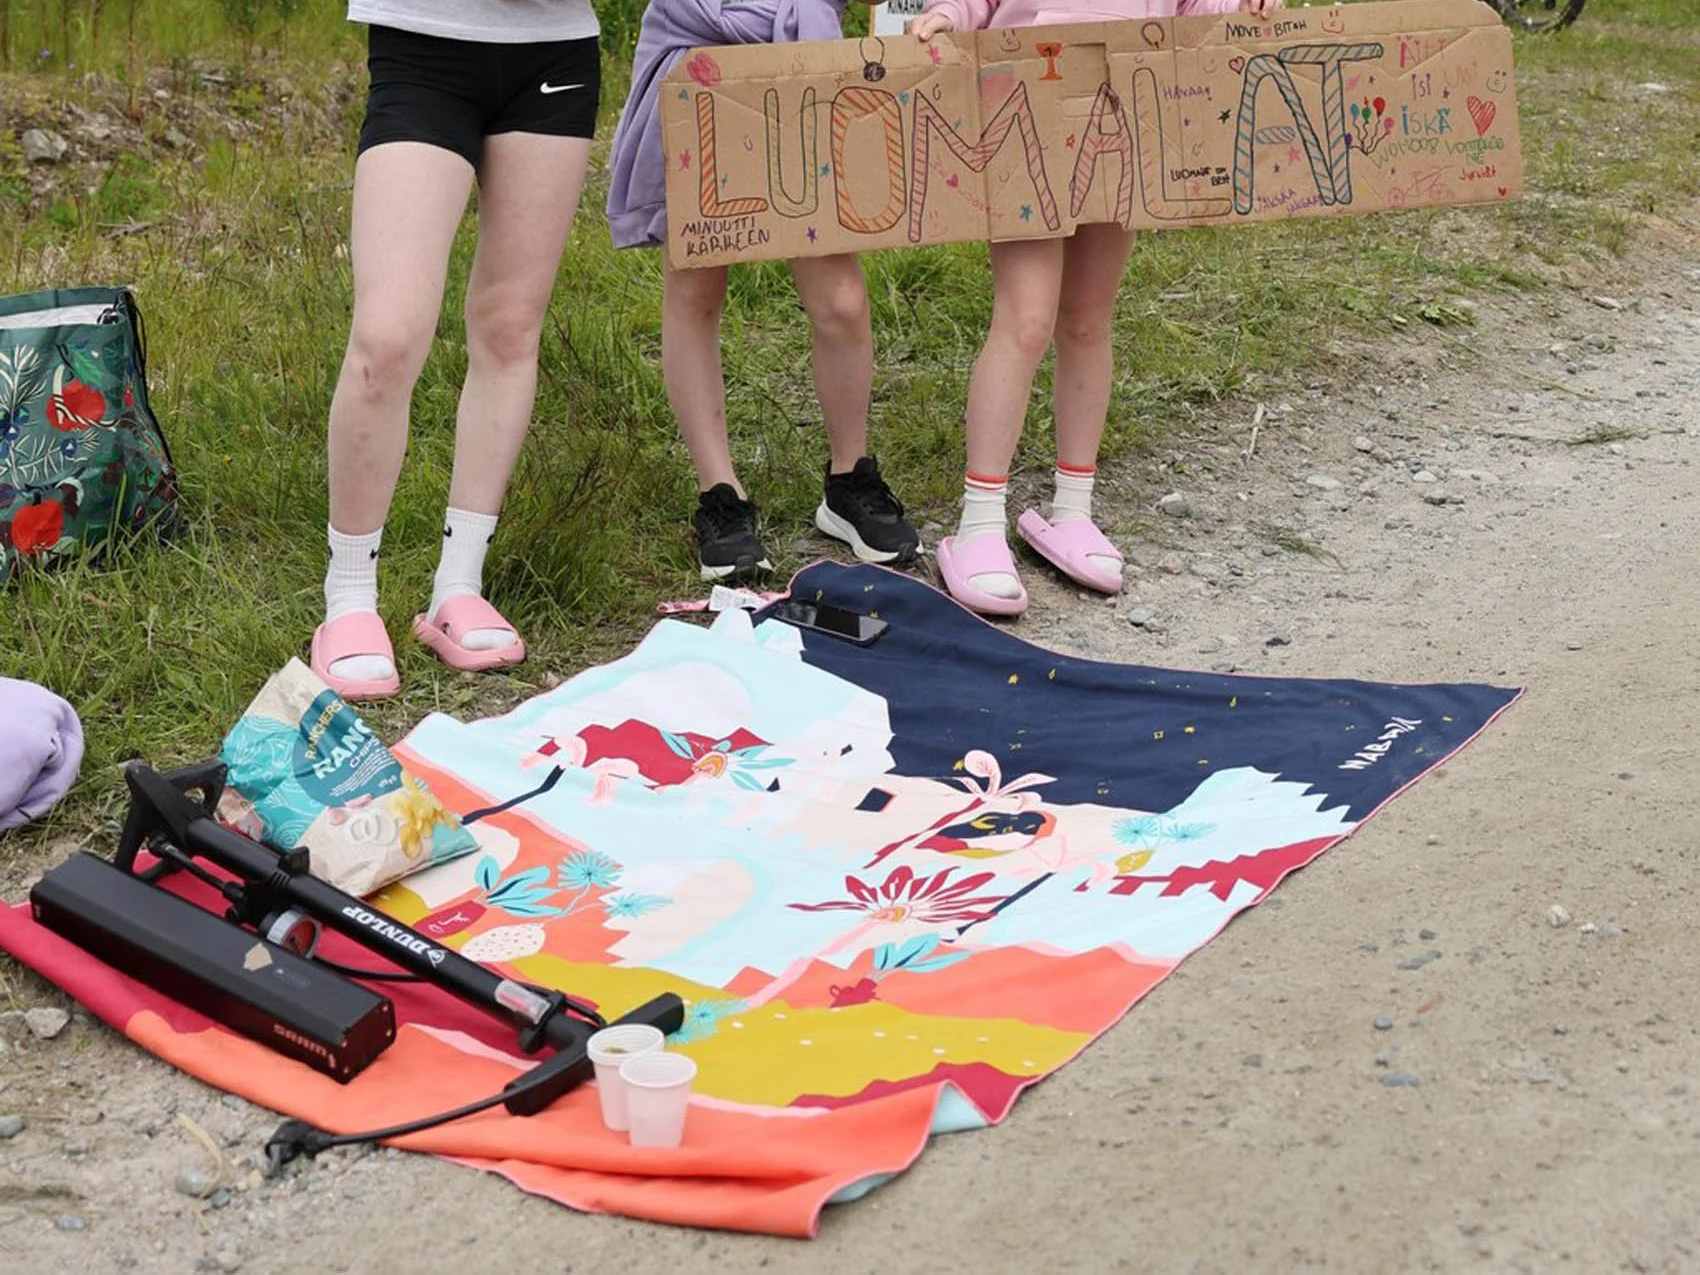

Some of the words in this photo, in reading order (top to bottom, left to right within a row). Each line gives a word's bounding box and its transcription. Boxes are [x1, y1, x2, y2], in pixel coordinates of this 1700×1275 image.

[1225, 21, 1261, 41] MOVE
[696, 43, 1384, 243] LUOMALAT
[680, 216, 756, 237] MINUUTTI
[686, 229, 770, 257] KÄRKEEN
[312, 717, 373, 780] RANC
[342, 906, 431, 955] DUNLOP
